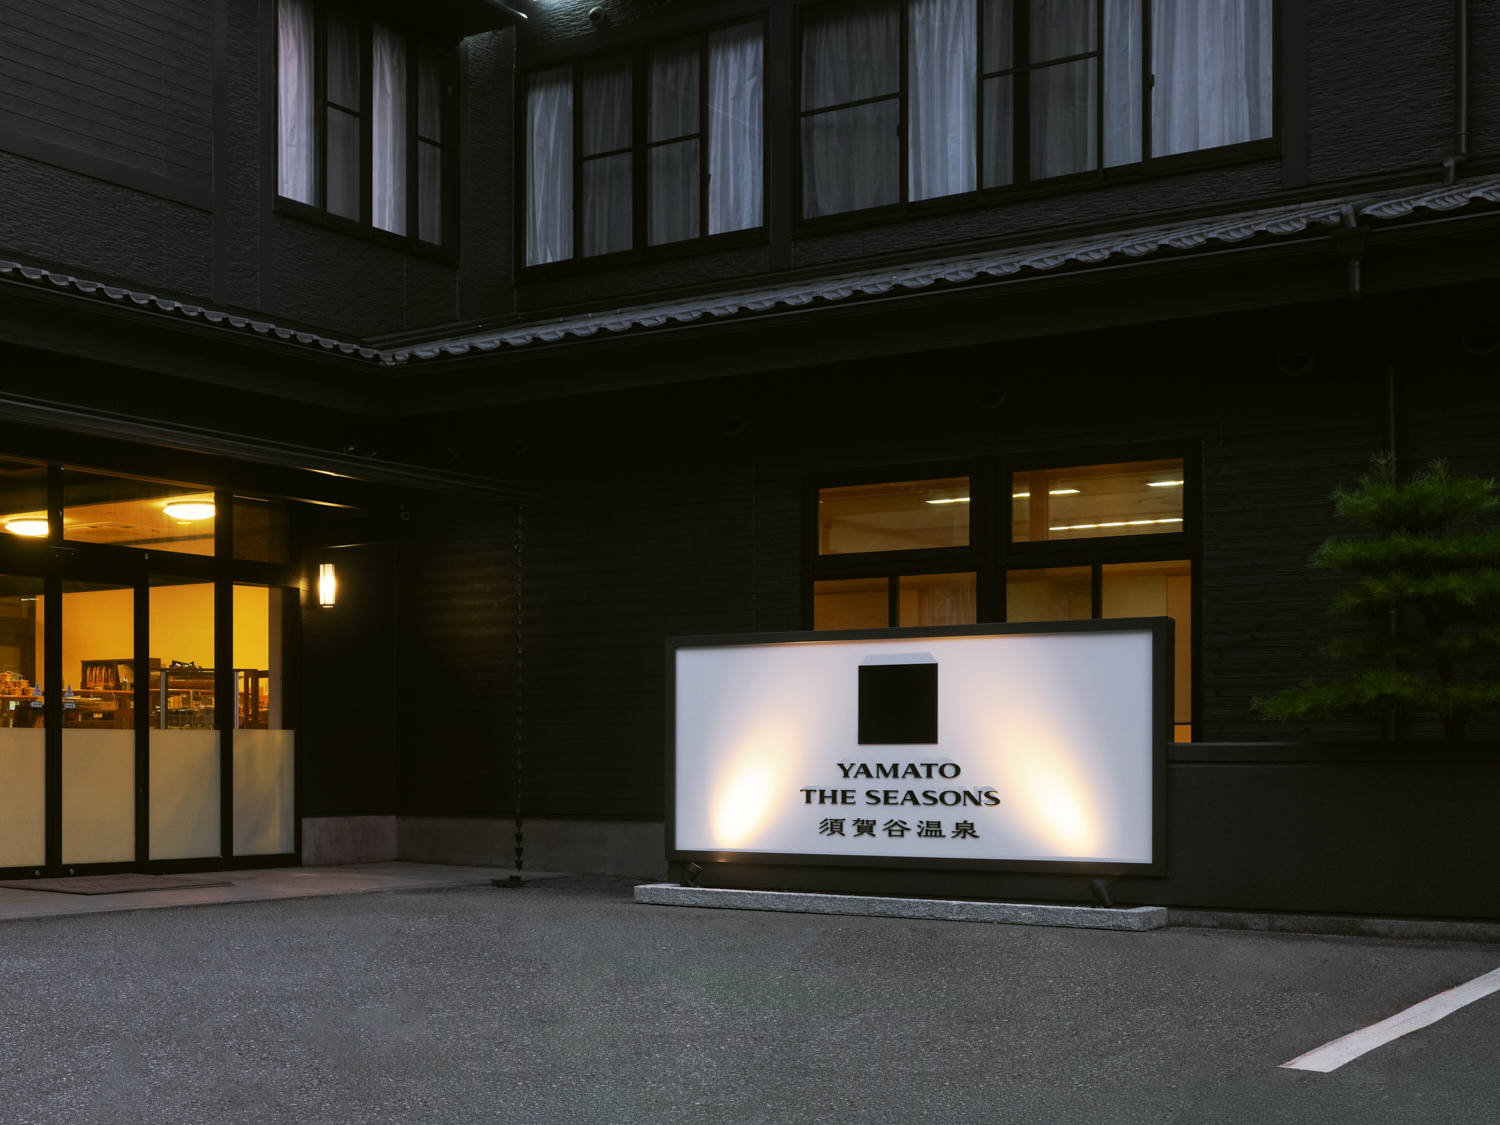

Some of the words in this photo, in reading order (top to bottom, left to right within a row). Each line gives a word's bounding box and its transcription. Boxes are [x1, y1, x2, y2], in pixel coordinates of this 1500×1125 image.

[836, 762, 961, 779] YAMATO
[800, 789, 856, 806] THE
[865, 789, 1001, 806] SEASONS
[819, 817, 980, 839] 須賀谷温泉
